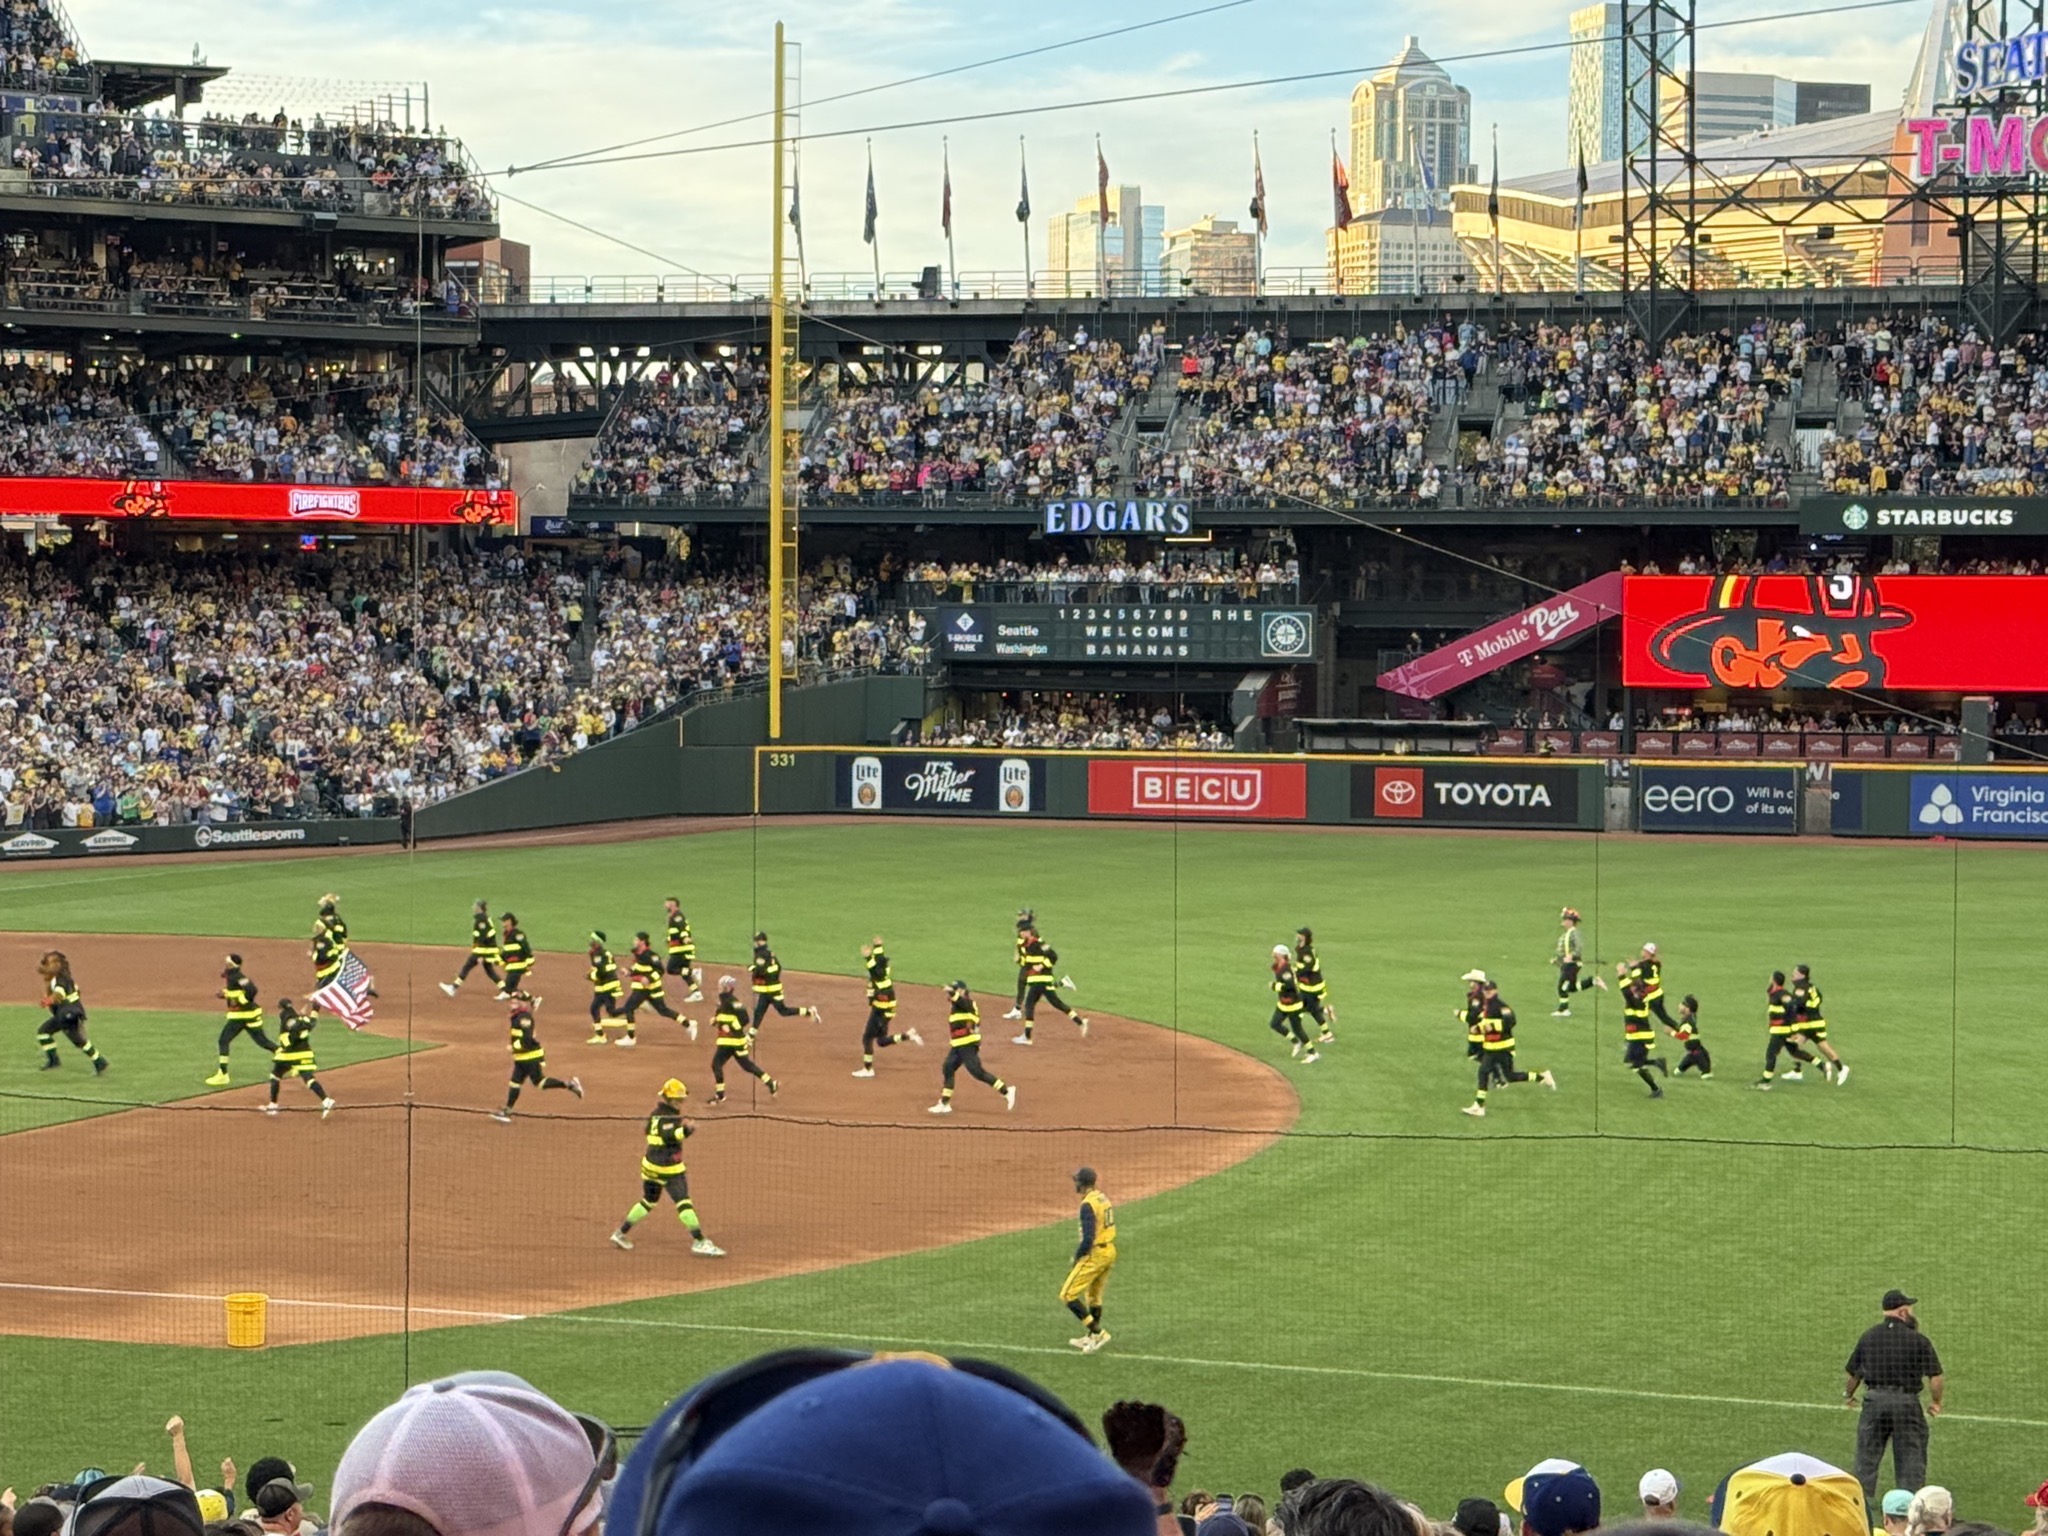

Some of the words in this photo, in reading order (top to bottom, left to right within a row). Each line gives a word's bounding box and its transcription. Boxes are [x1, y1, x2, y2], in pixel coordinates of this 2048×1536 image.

[1046, 501, 1190, 533] EDGAR'S
[1877, 509, 2013, 525] STARBUCKS
[1059, 609, 1065, 620] 1
[1072, 609, 1081, 620] 2
[1088, 609, 1096, 620] 3
[1103, 609, 1111, 620] 4
[1118, 609, 1126, 620] 5
[1133, 609, 1141, 620] 6
[1148, 609, 1156, 620] 7
[1164, 609, 1172, 620] 8
[1180, 609, 1188, 620] 9
[1212, 610, 1221, 621] R
[1228, 610, 1237, 621] H
[1244, 610, 1253, 621] E
[998, 624, 1039, 636] Seattle
[954, 643, 976, 652] PARK
[995, 643, 1048, 656] Washington
[1474, 628, 1531, 661] Mobile
[770, 753, 795, 766] 331
[856, 764, 879, 781] Lite
[924, 761, 954, 775] IT'S
[1003, 767, 1027, 784] Lite
[905, 769, 976, 801] Miller
[1144, 776, 1251, 801] BECU
[936, 788, 973, 802] TIME
[1434, 782, 1552, 807] TOYOTA
[1644, 785, 1734, 813] eero
[1746, 786, 1770, 798] Wifi
[1773, 787, 1784, 799] in
[1971, 785, 2045, 807] Virginia
[1745, 801, 1759, 814] of
[1761, 802, 1775, 814] its
[11, 840, 47, 848] SERVPRO
[93, 836, 127, 844] SERVPRO
